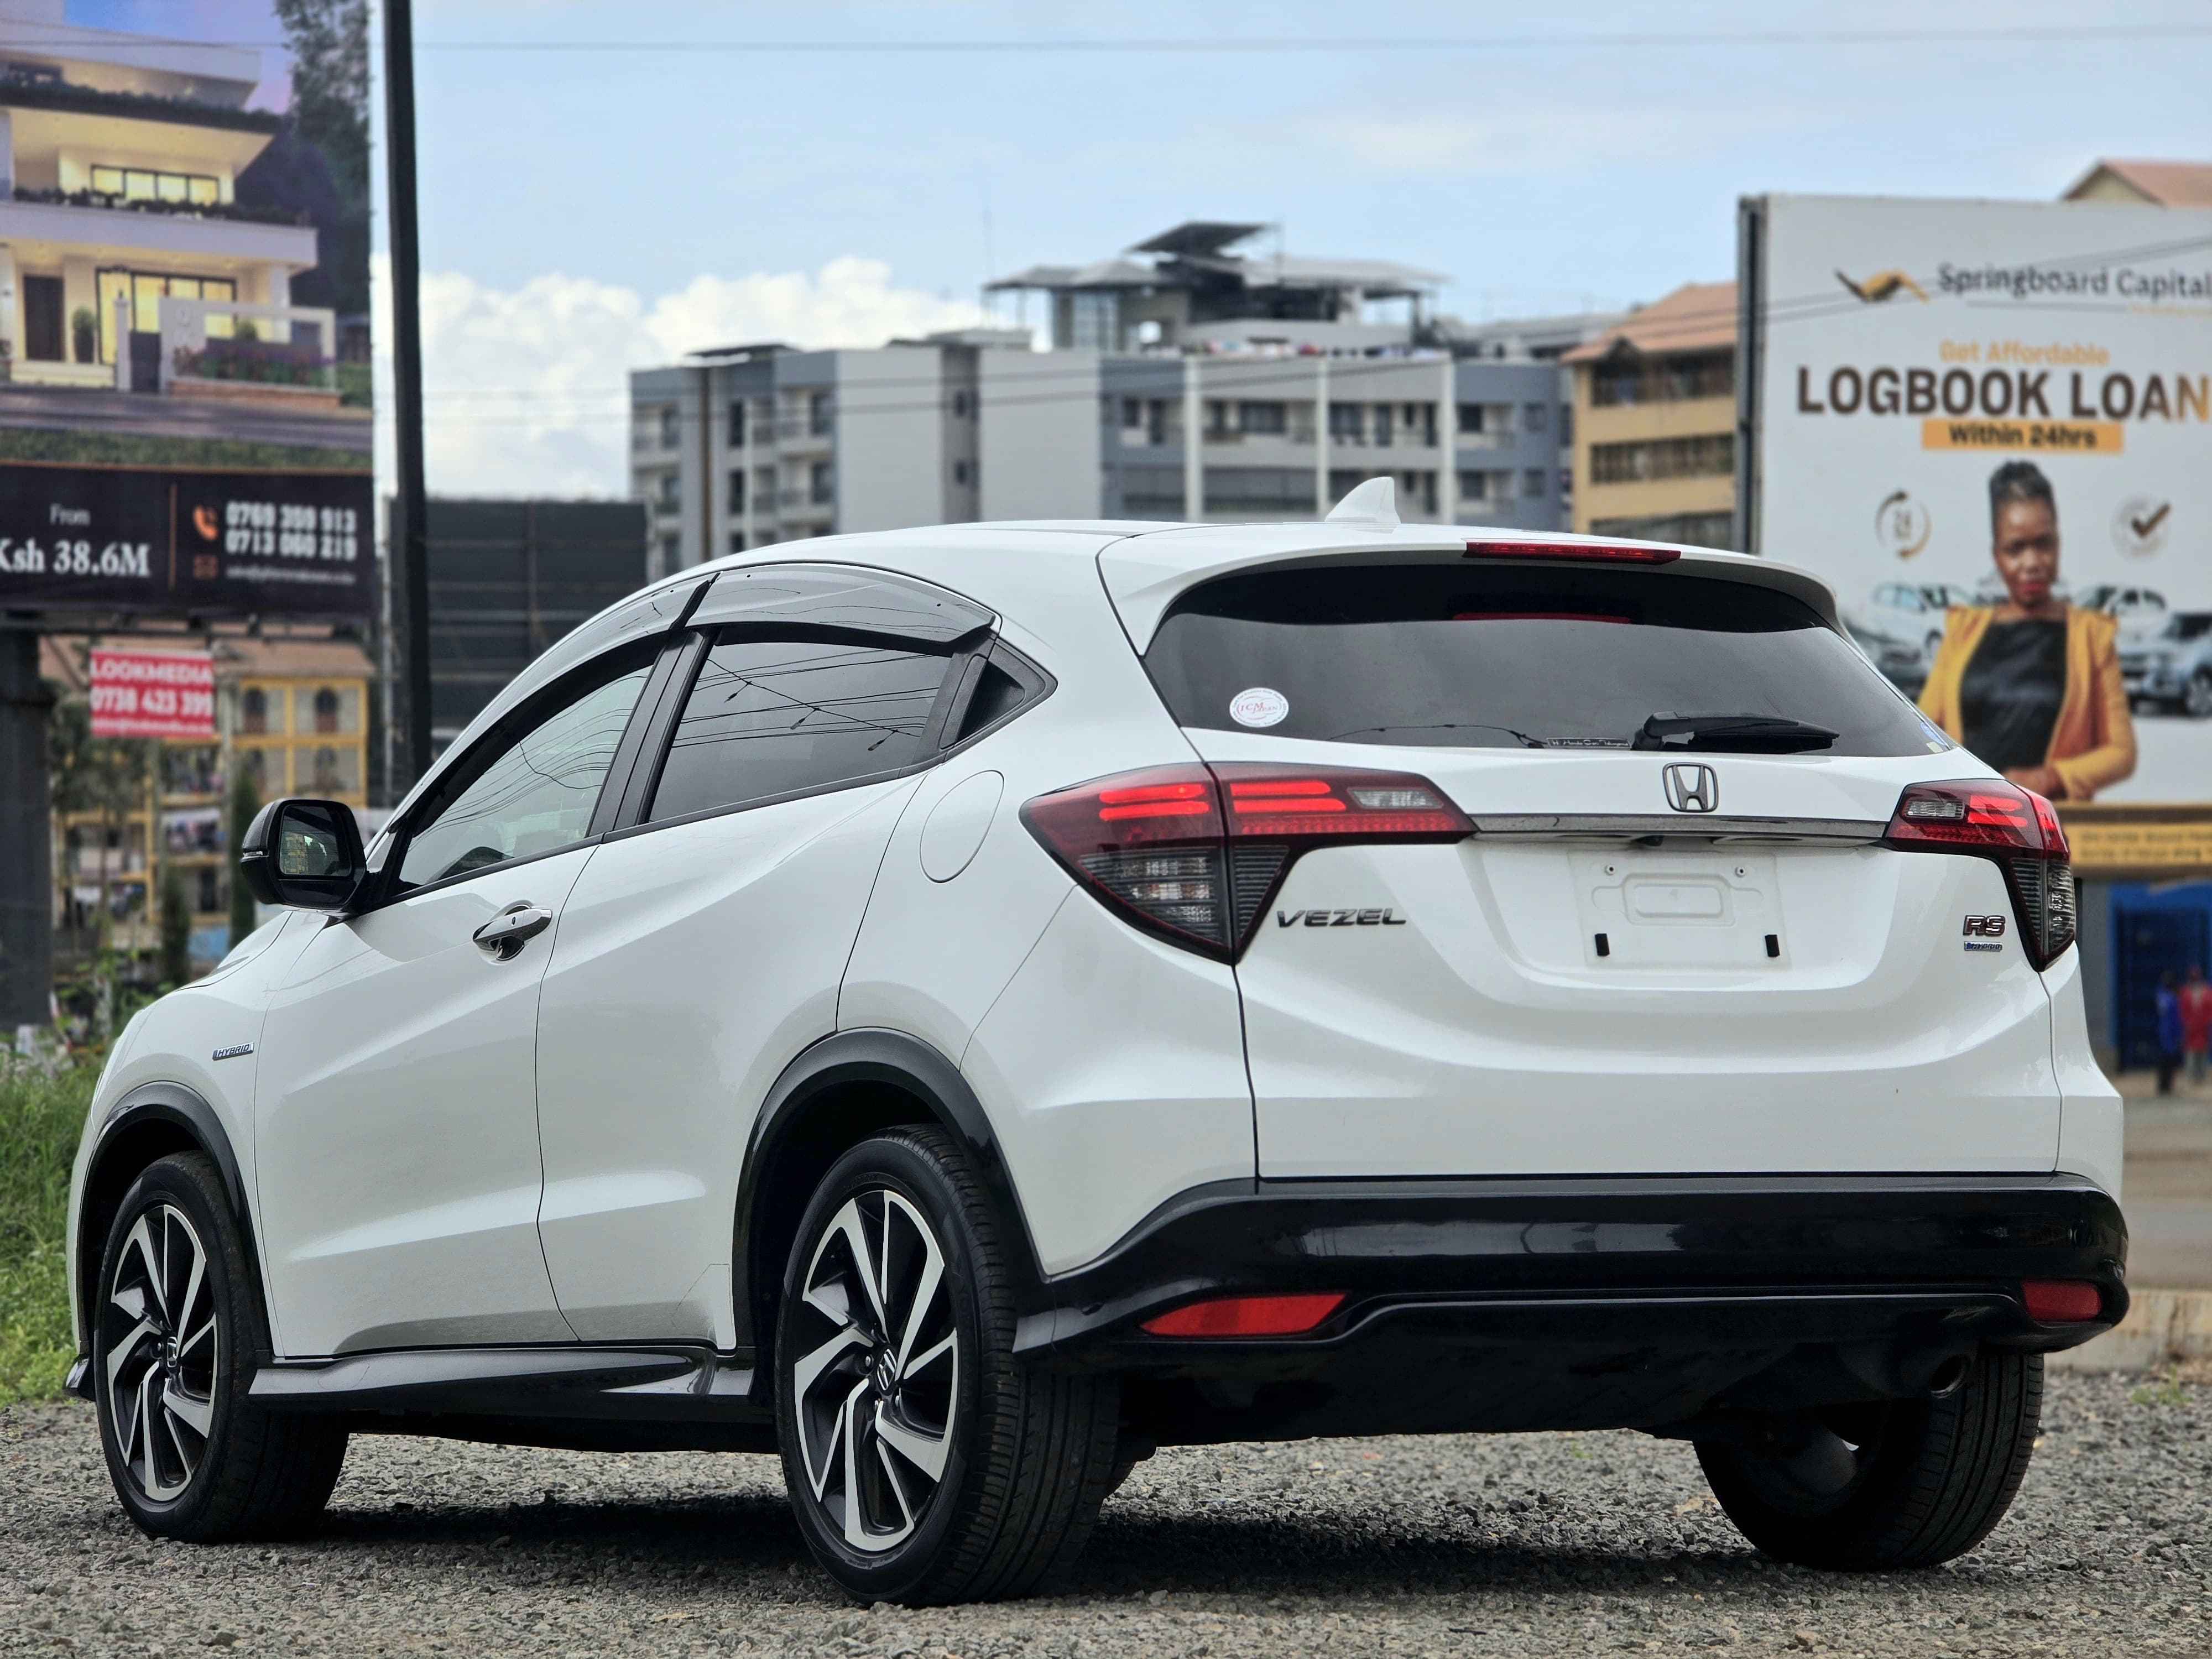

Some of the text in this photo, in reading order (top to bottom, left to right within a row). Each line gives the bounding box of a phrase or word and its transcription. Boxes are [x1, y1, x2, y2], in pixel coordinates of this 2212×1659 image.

[1938, 263, 2212, 301] Springboard Capital
[1939, 340, 2110, 367] Get Affordable
[1797, 366, 2210, 421] LOGBOOK LOAN
[1948, 422, 2098, 448] Within 24hrs
[50, 503, 90, 524] From
[226, 529, 275, 555] 0713
[54, 539, 152, 577] 38.6M
[90, 658, 214, 685] LOOKMEDIA
[1277, 908, 1406, 928] VEZEL
[1963, 915, 2006, 936] RS
[217, 1044, 250, 1057] HYBRID
